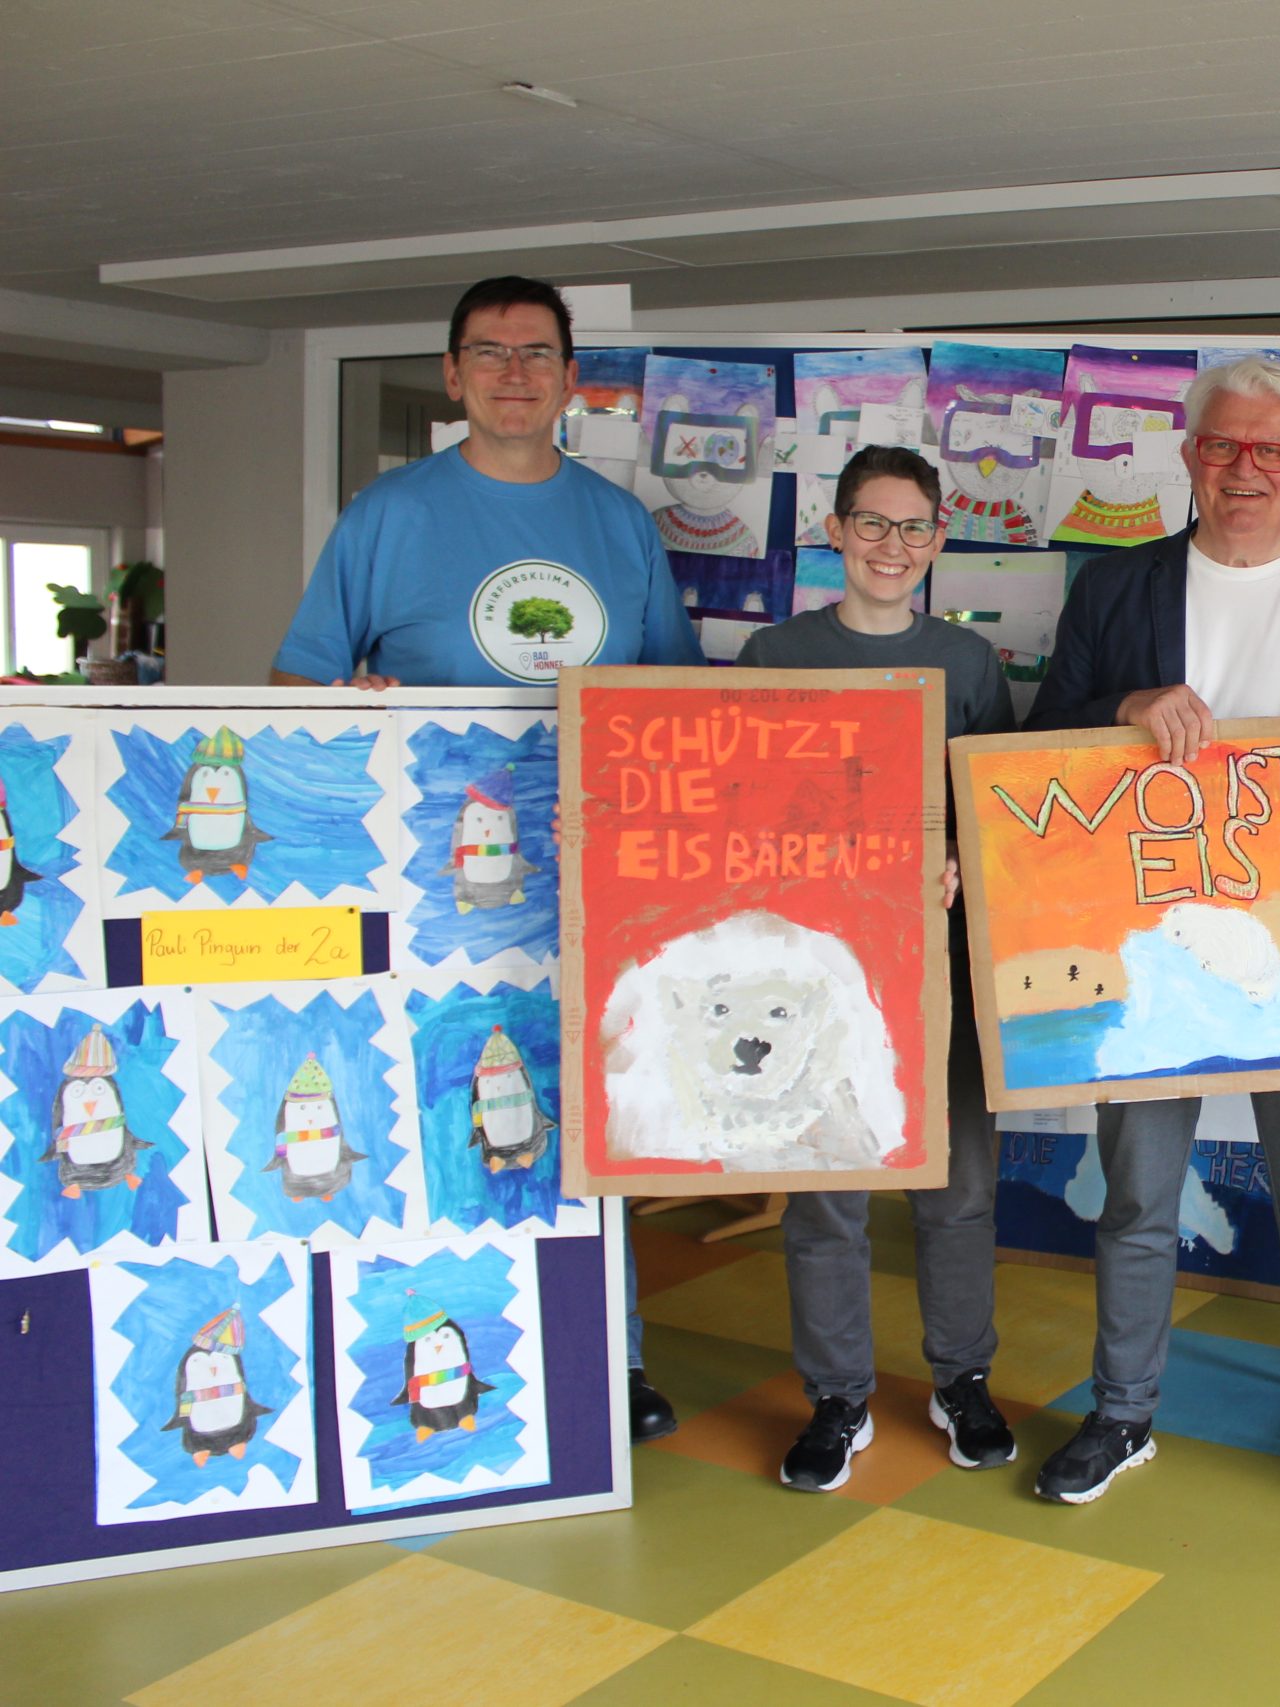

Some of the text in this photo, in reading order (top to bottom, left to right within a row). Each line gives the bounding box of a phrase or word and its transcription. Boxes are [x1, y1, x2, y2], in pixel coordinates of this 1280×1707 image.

[532, 651, 549, 661] BAD
[607, 706, 860, 766] SCHÜTZT
[620, 767, 718, 814] DIE
[991, 761, 1205, 838] WO
[145, 928, 187, 957] Pauli
[193, 928, 261, 966] Pinguin
[276, 937, 301, 955] der
[1008, 1133, 1057, 1166] DIE
